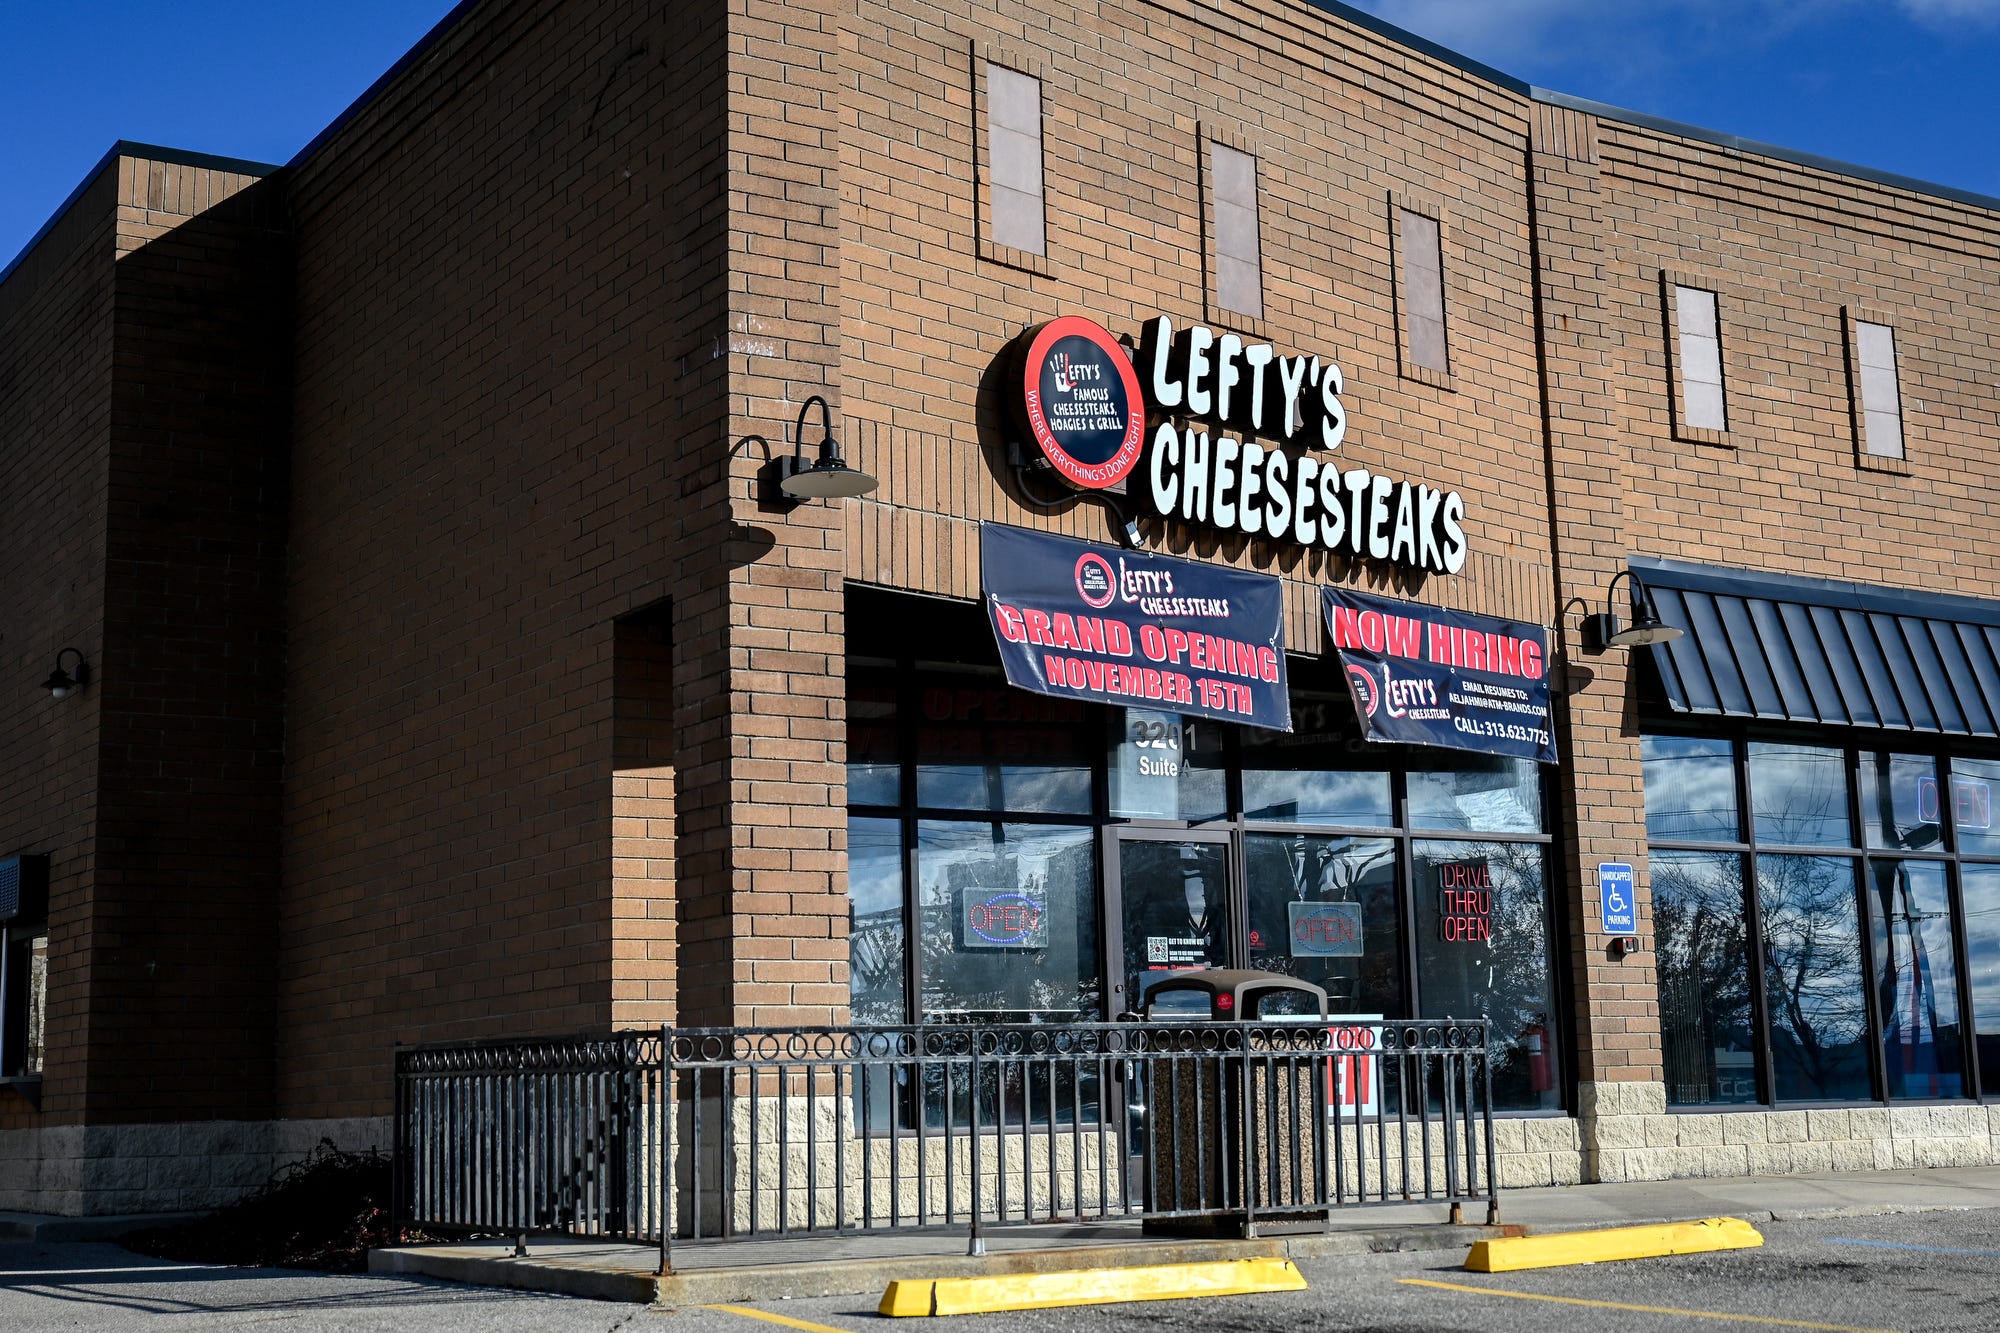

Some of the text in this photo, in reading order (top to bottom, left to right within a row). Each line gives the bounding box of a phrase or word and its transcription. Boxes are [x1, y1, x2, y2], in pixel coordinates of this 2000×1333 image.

[1064, 353, 1100, 387] LEFTY'S
[1153, 315, 1347, 450] LEFTY'S
[1073, 388, 1109, 401] FAMOUS
[1053, 402, 1118, 416] CHEESESTEAKS,
[1027, 390, 1047, 438] WHERE
[1043, 436, 1107, 481] EVERYTHING'S
[1105, 453, 1131, 478] DONE
[1050, 417, 1123, 431] HOAGIES & GRILL
[1151, 422, 1467, 575] CHEESESTEAKS
[1119, 556, 1174, 603] LEFTY'S
[1140, 597, 1230, 618] CHEESESTEAKS
[995, 604, 1280, 684] GRAND OPENING
[1332, 605, 1542, 680] NOW HIRING
[1044, 654, 1253, 715] NOVEMBER 15TH
[1384, 664, 1438, 718] LEFTY'S
[1462, 681, 1528, 701] EMAIL RESUMES TO:
[1408, 708, 1450, 720] CHEESESTEAKS
[1136, 720, 1196, 751] 3201
[1454, 716, 1549, 745] CALL: 313.623.7725
[1139, 755, 1178, 777] Suite
[1922, 782, 1987, 823] OEN
[1444, 864, 1493, 888] DRIVE
[1601, 870, 1631, 882] HANDICAPPED
[1444, 890, 1490, 915] THRU
[970, 905, 1038, 932] OPEN
[1295, 918, 1355, 943] OPEN
[1444, 916, 1490, 942] OPEN
[1607, 914, 1631, 926] PARKING
